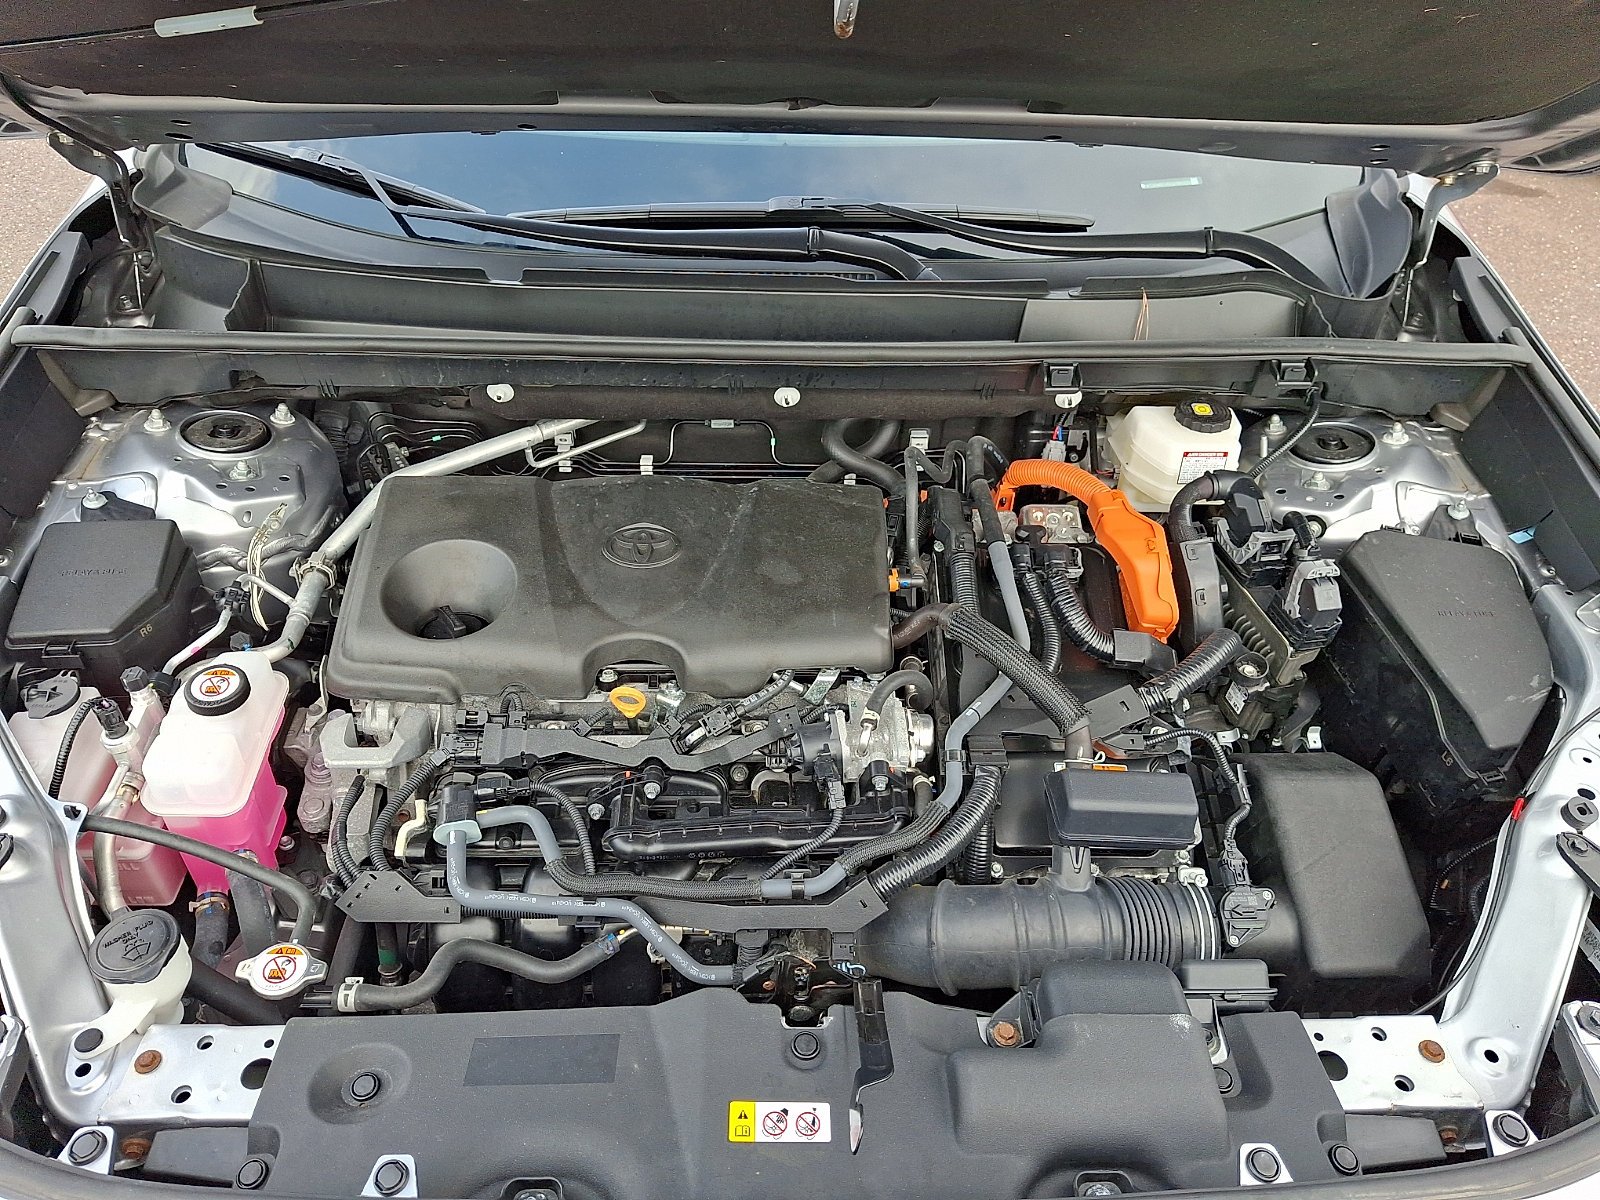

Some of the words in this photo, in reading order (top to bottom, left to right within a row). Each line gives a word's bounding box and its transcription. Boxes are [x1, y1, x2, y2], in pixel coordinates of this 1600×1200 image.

[139, 623, 153, 637] R6
[1441, 750, 1453, 767] L6
[104, 931, 131, 948] WASHER
